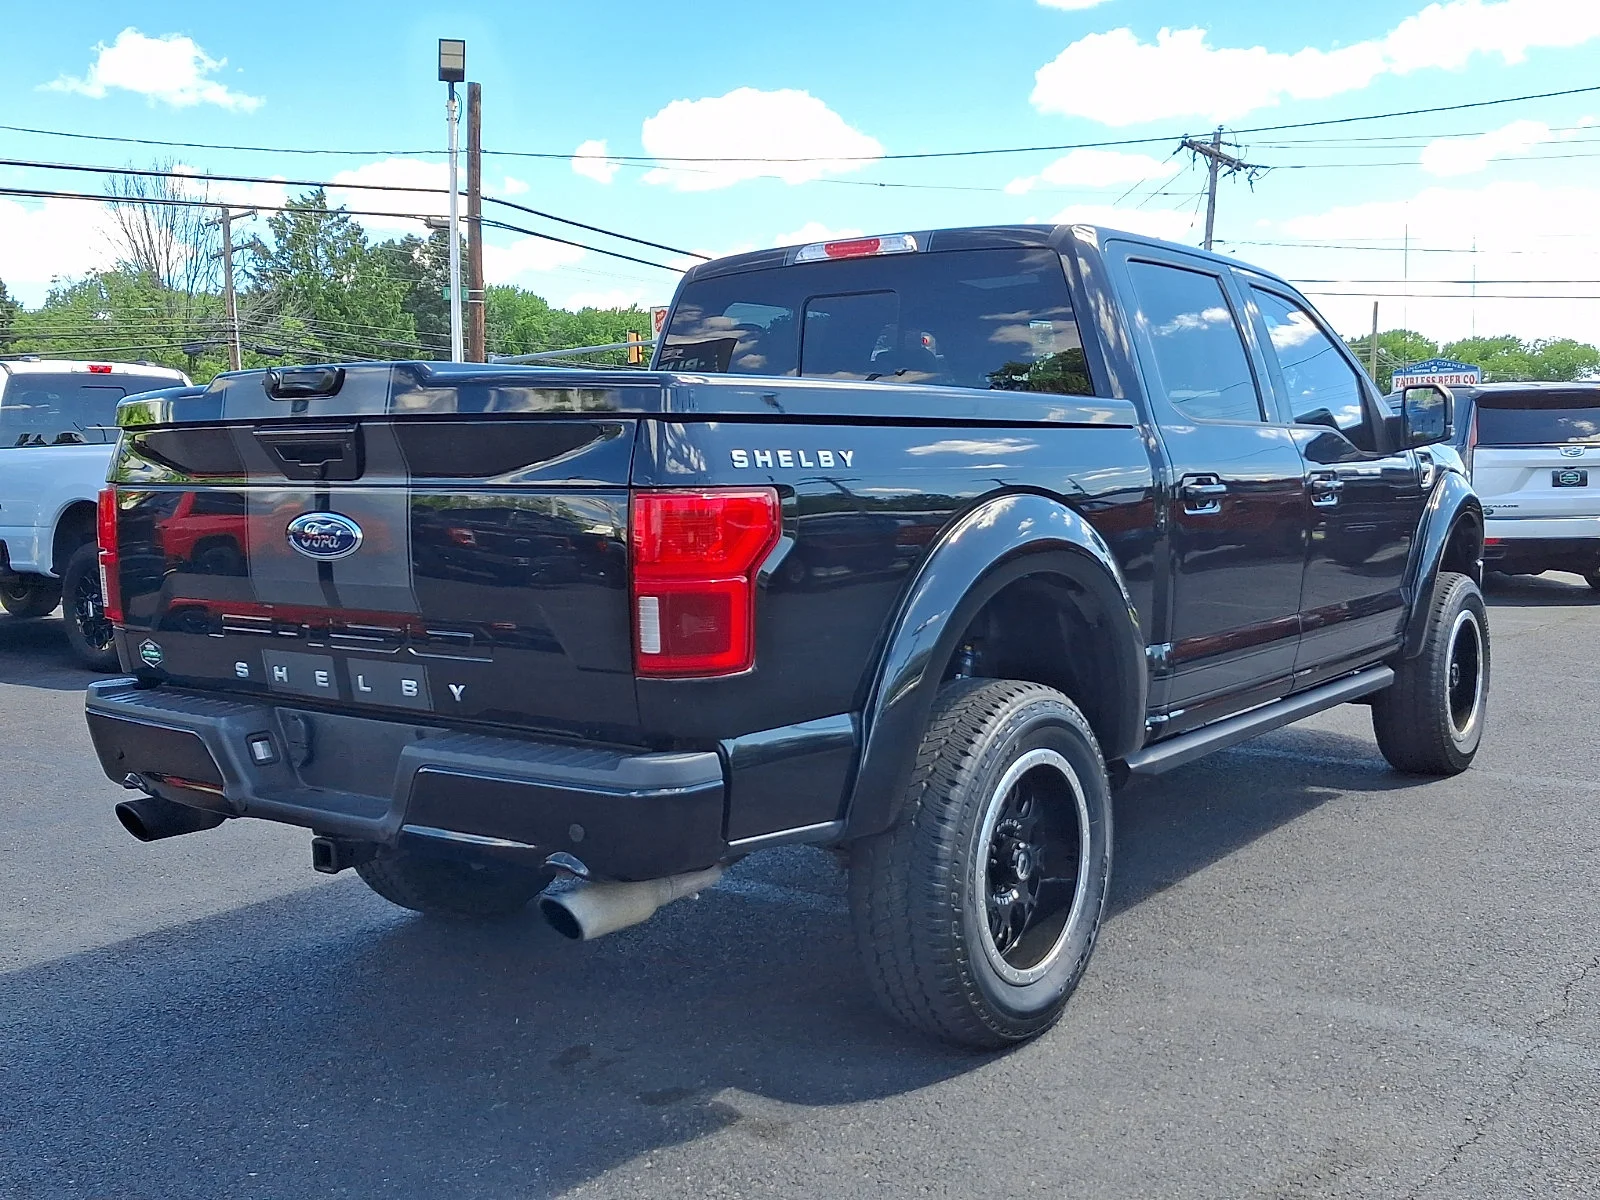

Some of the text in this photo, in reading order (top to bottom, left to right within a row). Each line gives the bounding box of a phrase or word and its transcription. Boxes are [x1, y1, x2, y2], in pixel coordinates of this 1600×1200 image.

[1402, 361, 1435, 373] LINCOLN
[1436, 361, 1466, 370] CORNER
[1438, 375, 1461, 385] BEER
[1463, 374, 1478, 385] CO.
[730, 448, 854, 469] SHELBY
[301, 521, 341, 549] Ford
[234, 661, 466, 701] SHELBY
